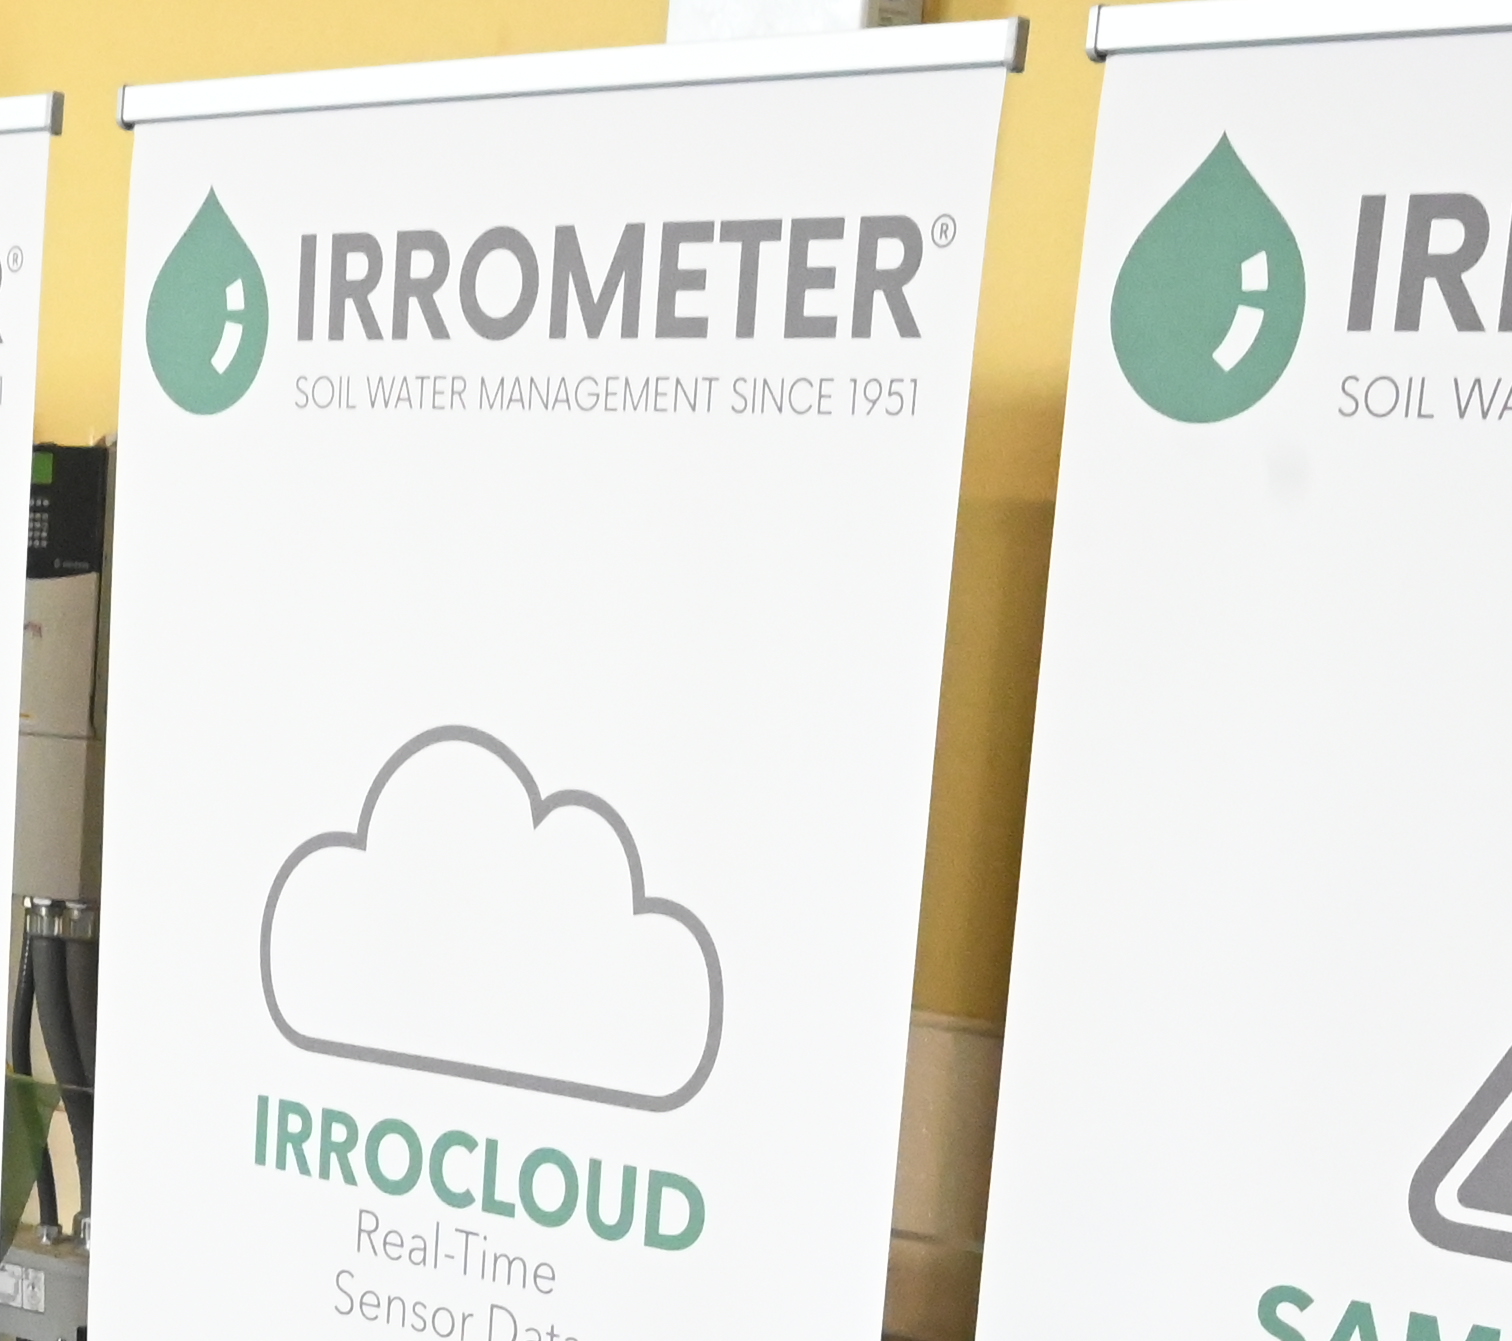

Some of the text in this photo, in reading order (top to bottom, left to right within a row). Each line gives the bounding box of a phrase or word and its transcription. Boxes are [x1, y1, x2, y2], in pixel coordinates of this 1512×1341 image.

[294, 375, 919, 418] SOIL WATER MANAGEMENT SINCE 1951
[1337, 374, 1434, 421] SOIL
[254, 1093, 706, 1252] IRROCLOUD
[355, 1208, 556, 1295] Real-Time
[334, 1269, 474, 1341] Sensor
